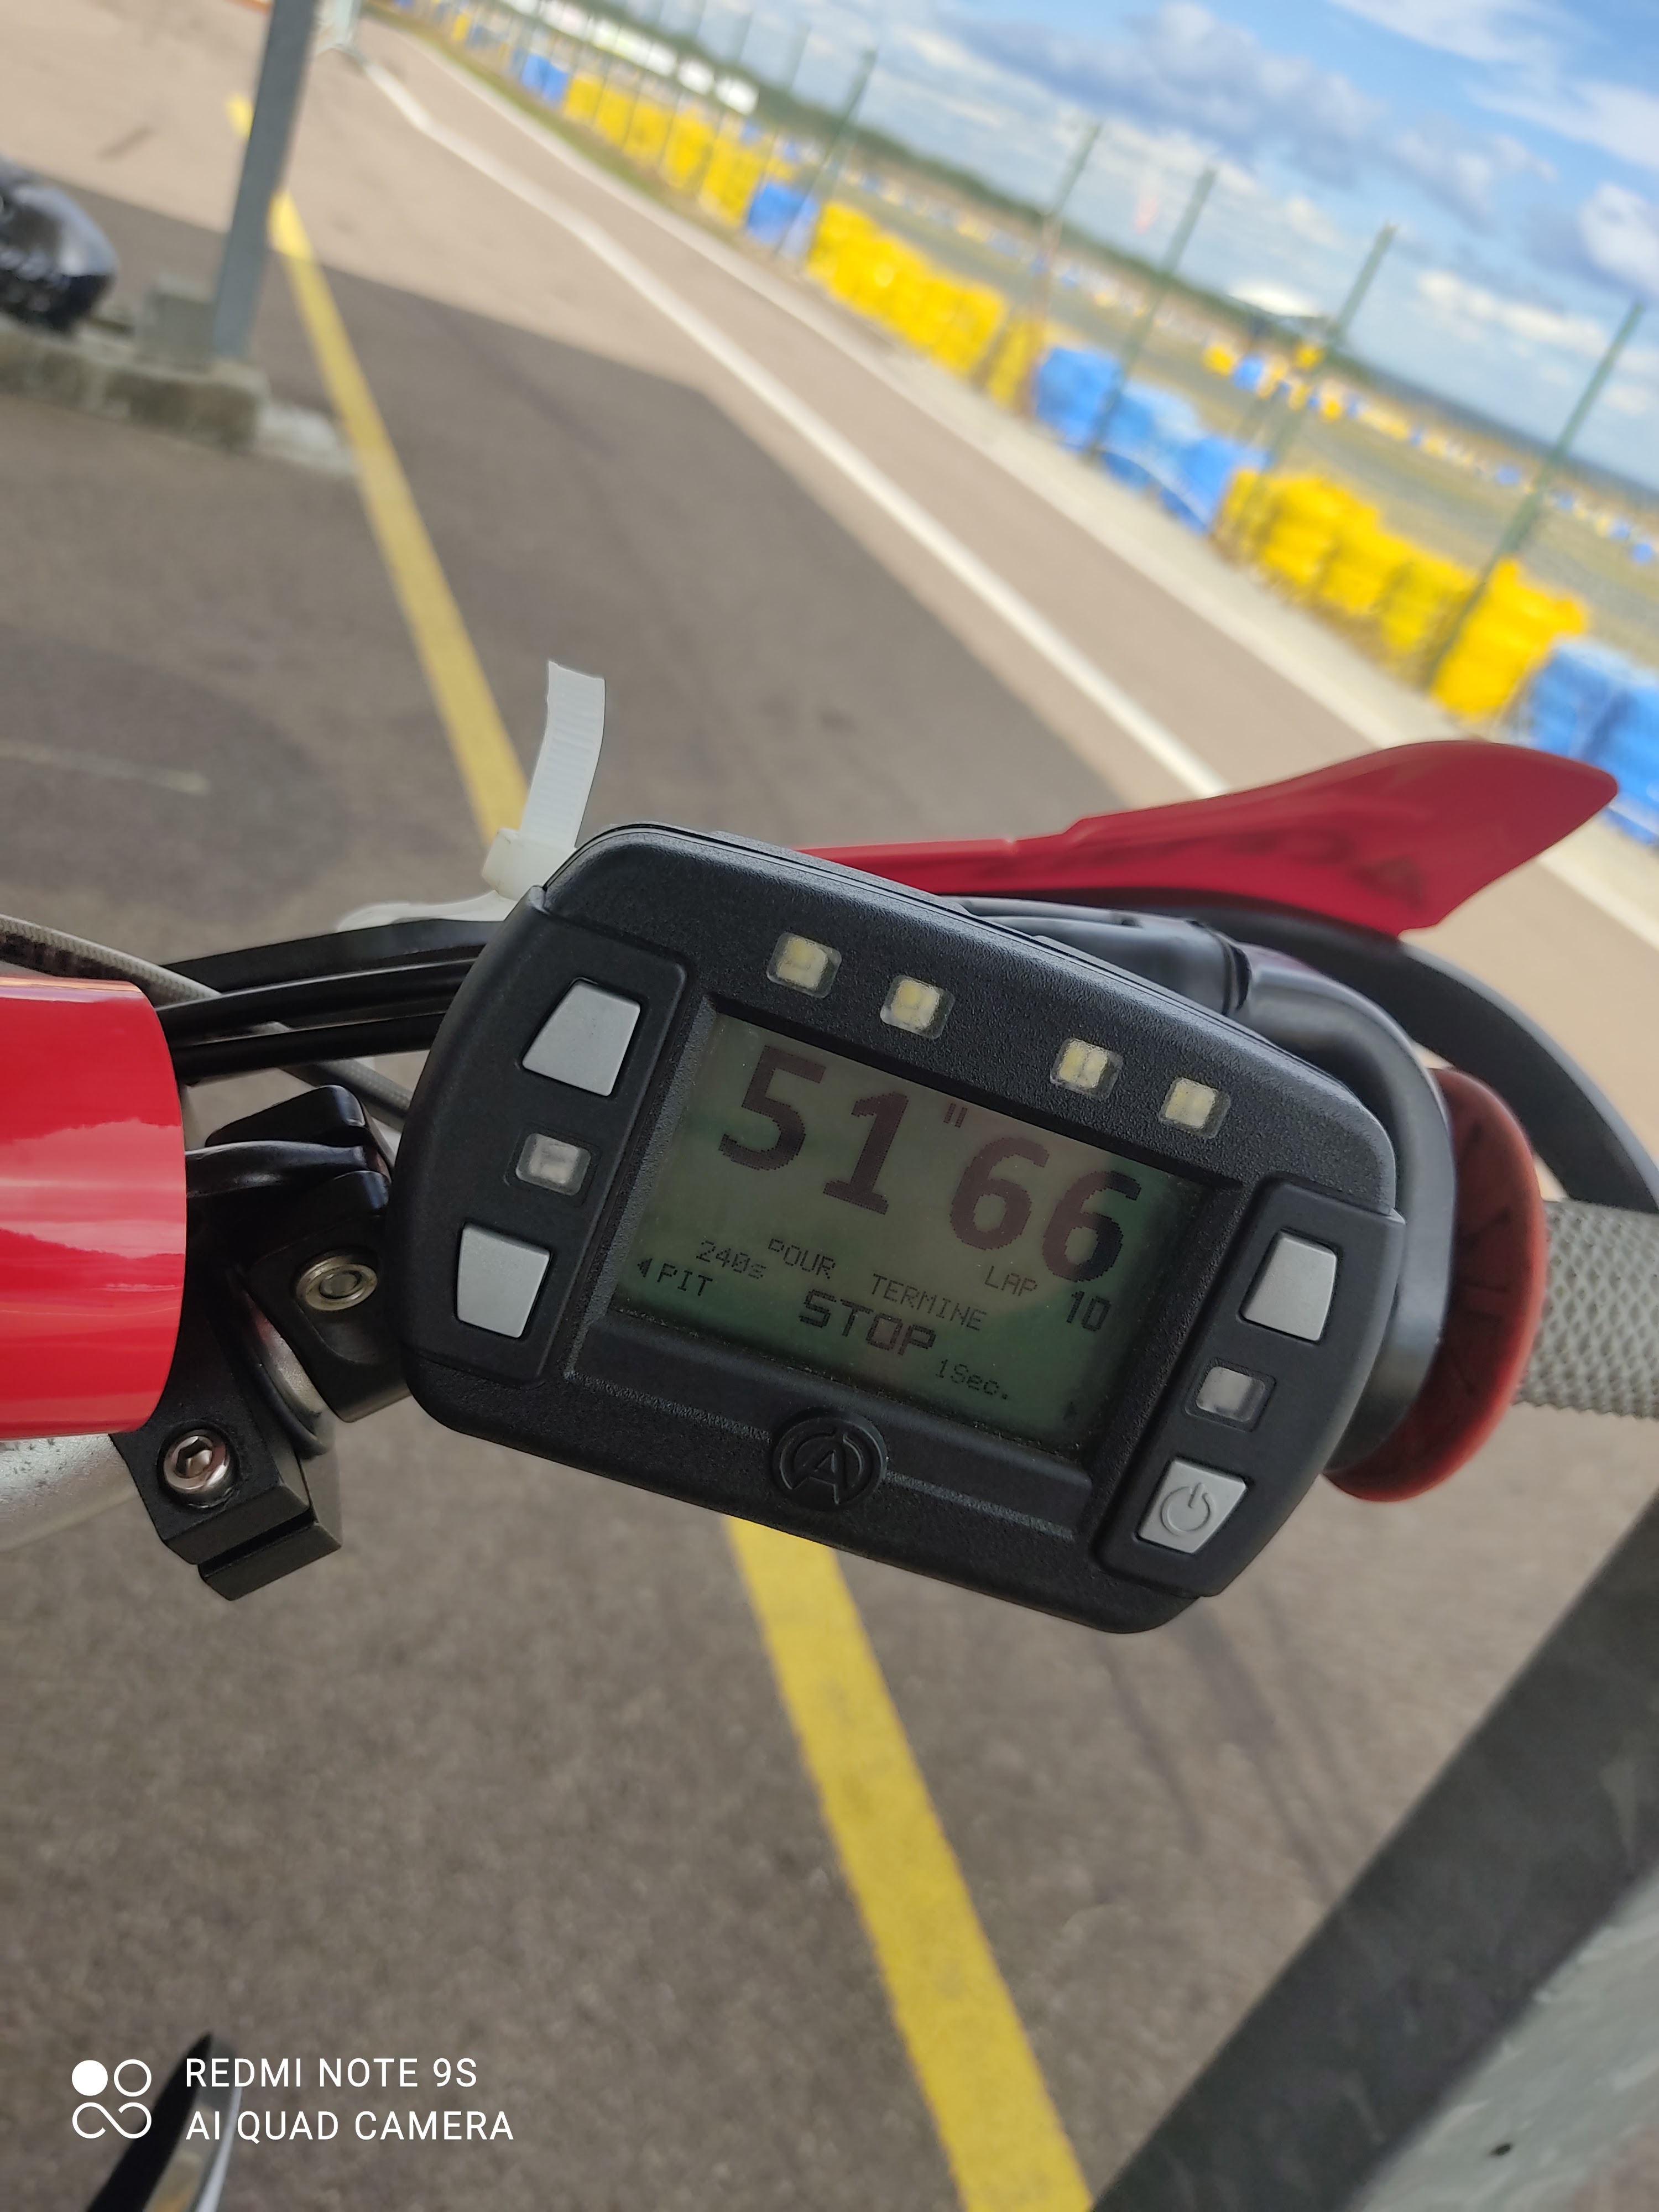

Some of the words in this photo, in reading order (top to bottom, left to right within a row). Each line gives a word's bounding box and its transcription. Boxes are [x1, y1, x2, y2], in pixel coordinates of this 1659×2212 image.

[657, 1262, 713, 1296] PIT
[696, 1240, 766, 1279] 240s
[768, 1238, 836, 1279] POUR
[872, 1273, 987, 1331] TERMINE
[799, 1289, 937, 1356] STOP
[984, 1265, 1038, 1296] LAP
[1066, 1291, 1112, 1332] 10
[935, 1359, 1009, 1400] 1Sec.
